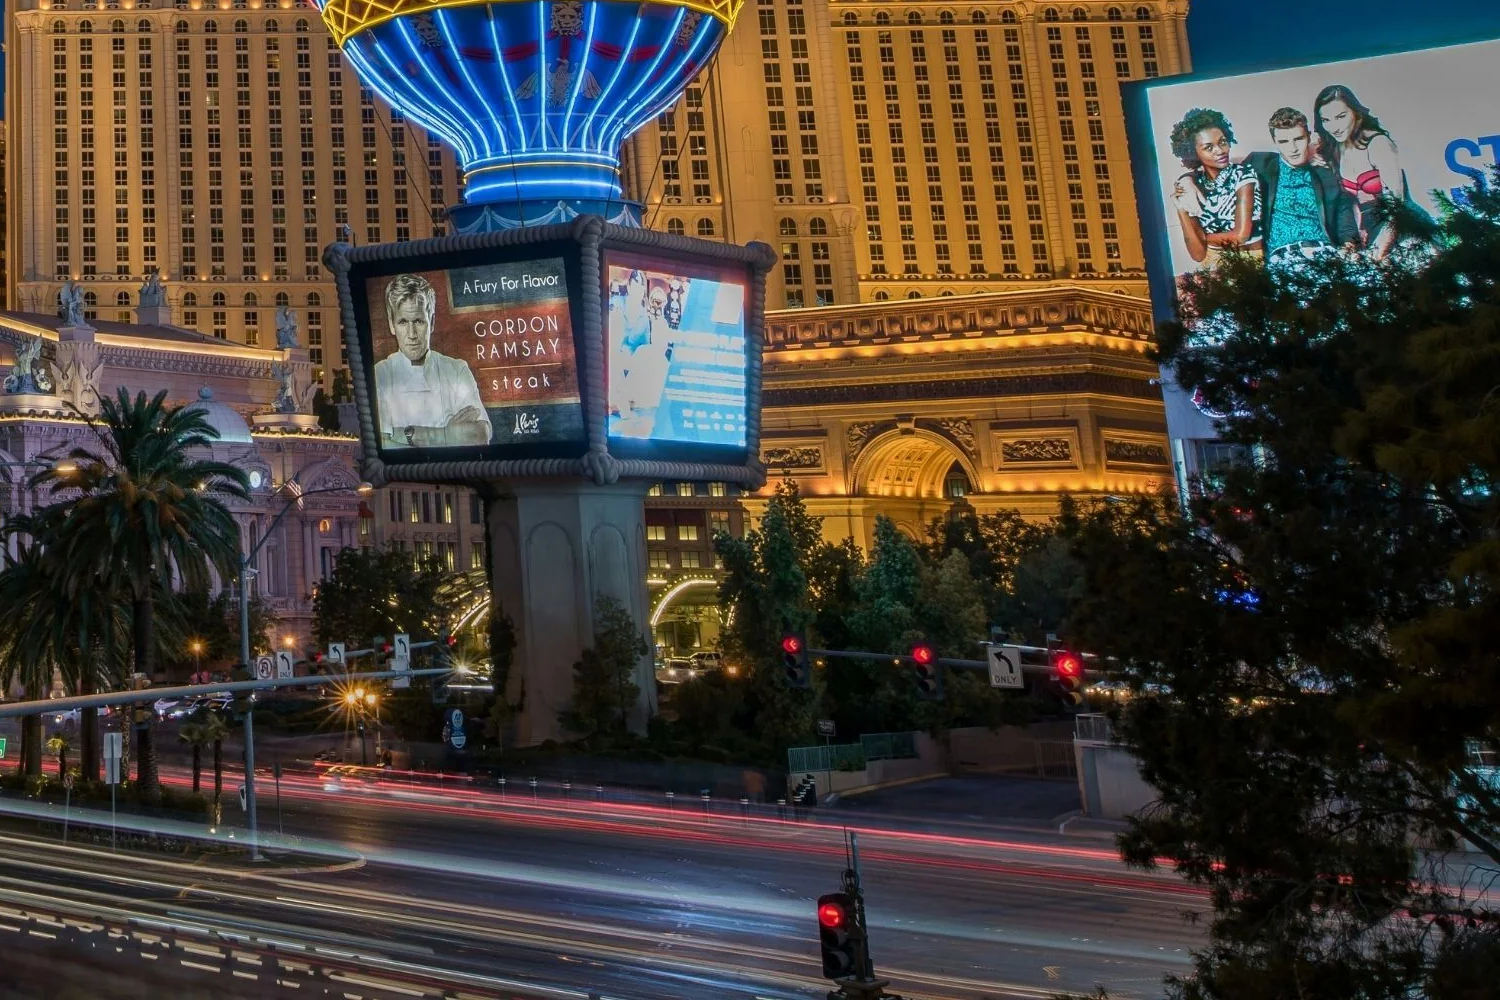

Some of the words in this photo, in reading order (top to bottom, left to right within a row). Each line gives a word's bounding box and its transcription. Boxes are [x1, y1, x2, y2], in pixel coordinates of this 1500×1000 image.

[463, 281, 472, 295] A
[474, 279, 497, 294] Fury
[501, 276, 519, 291] For
[522, 274, 559, 289] Flavor
[474, 315, 559, 338] GORDON
[476, 338, 560, 360] RAMSAY
[492, 373, 551, 391] steak
[520, 413, 539, 430] Paris
[995, 676, 1017, 684] ONLY
